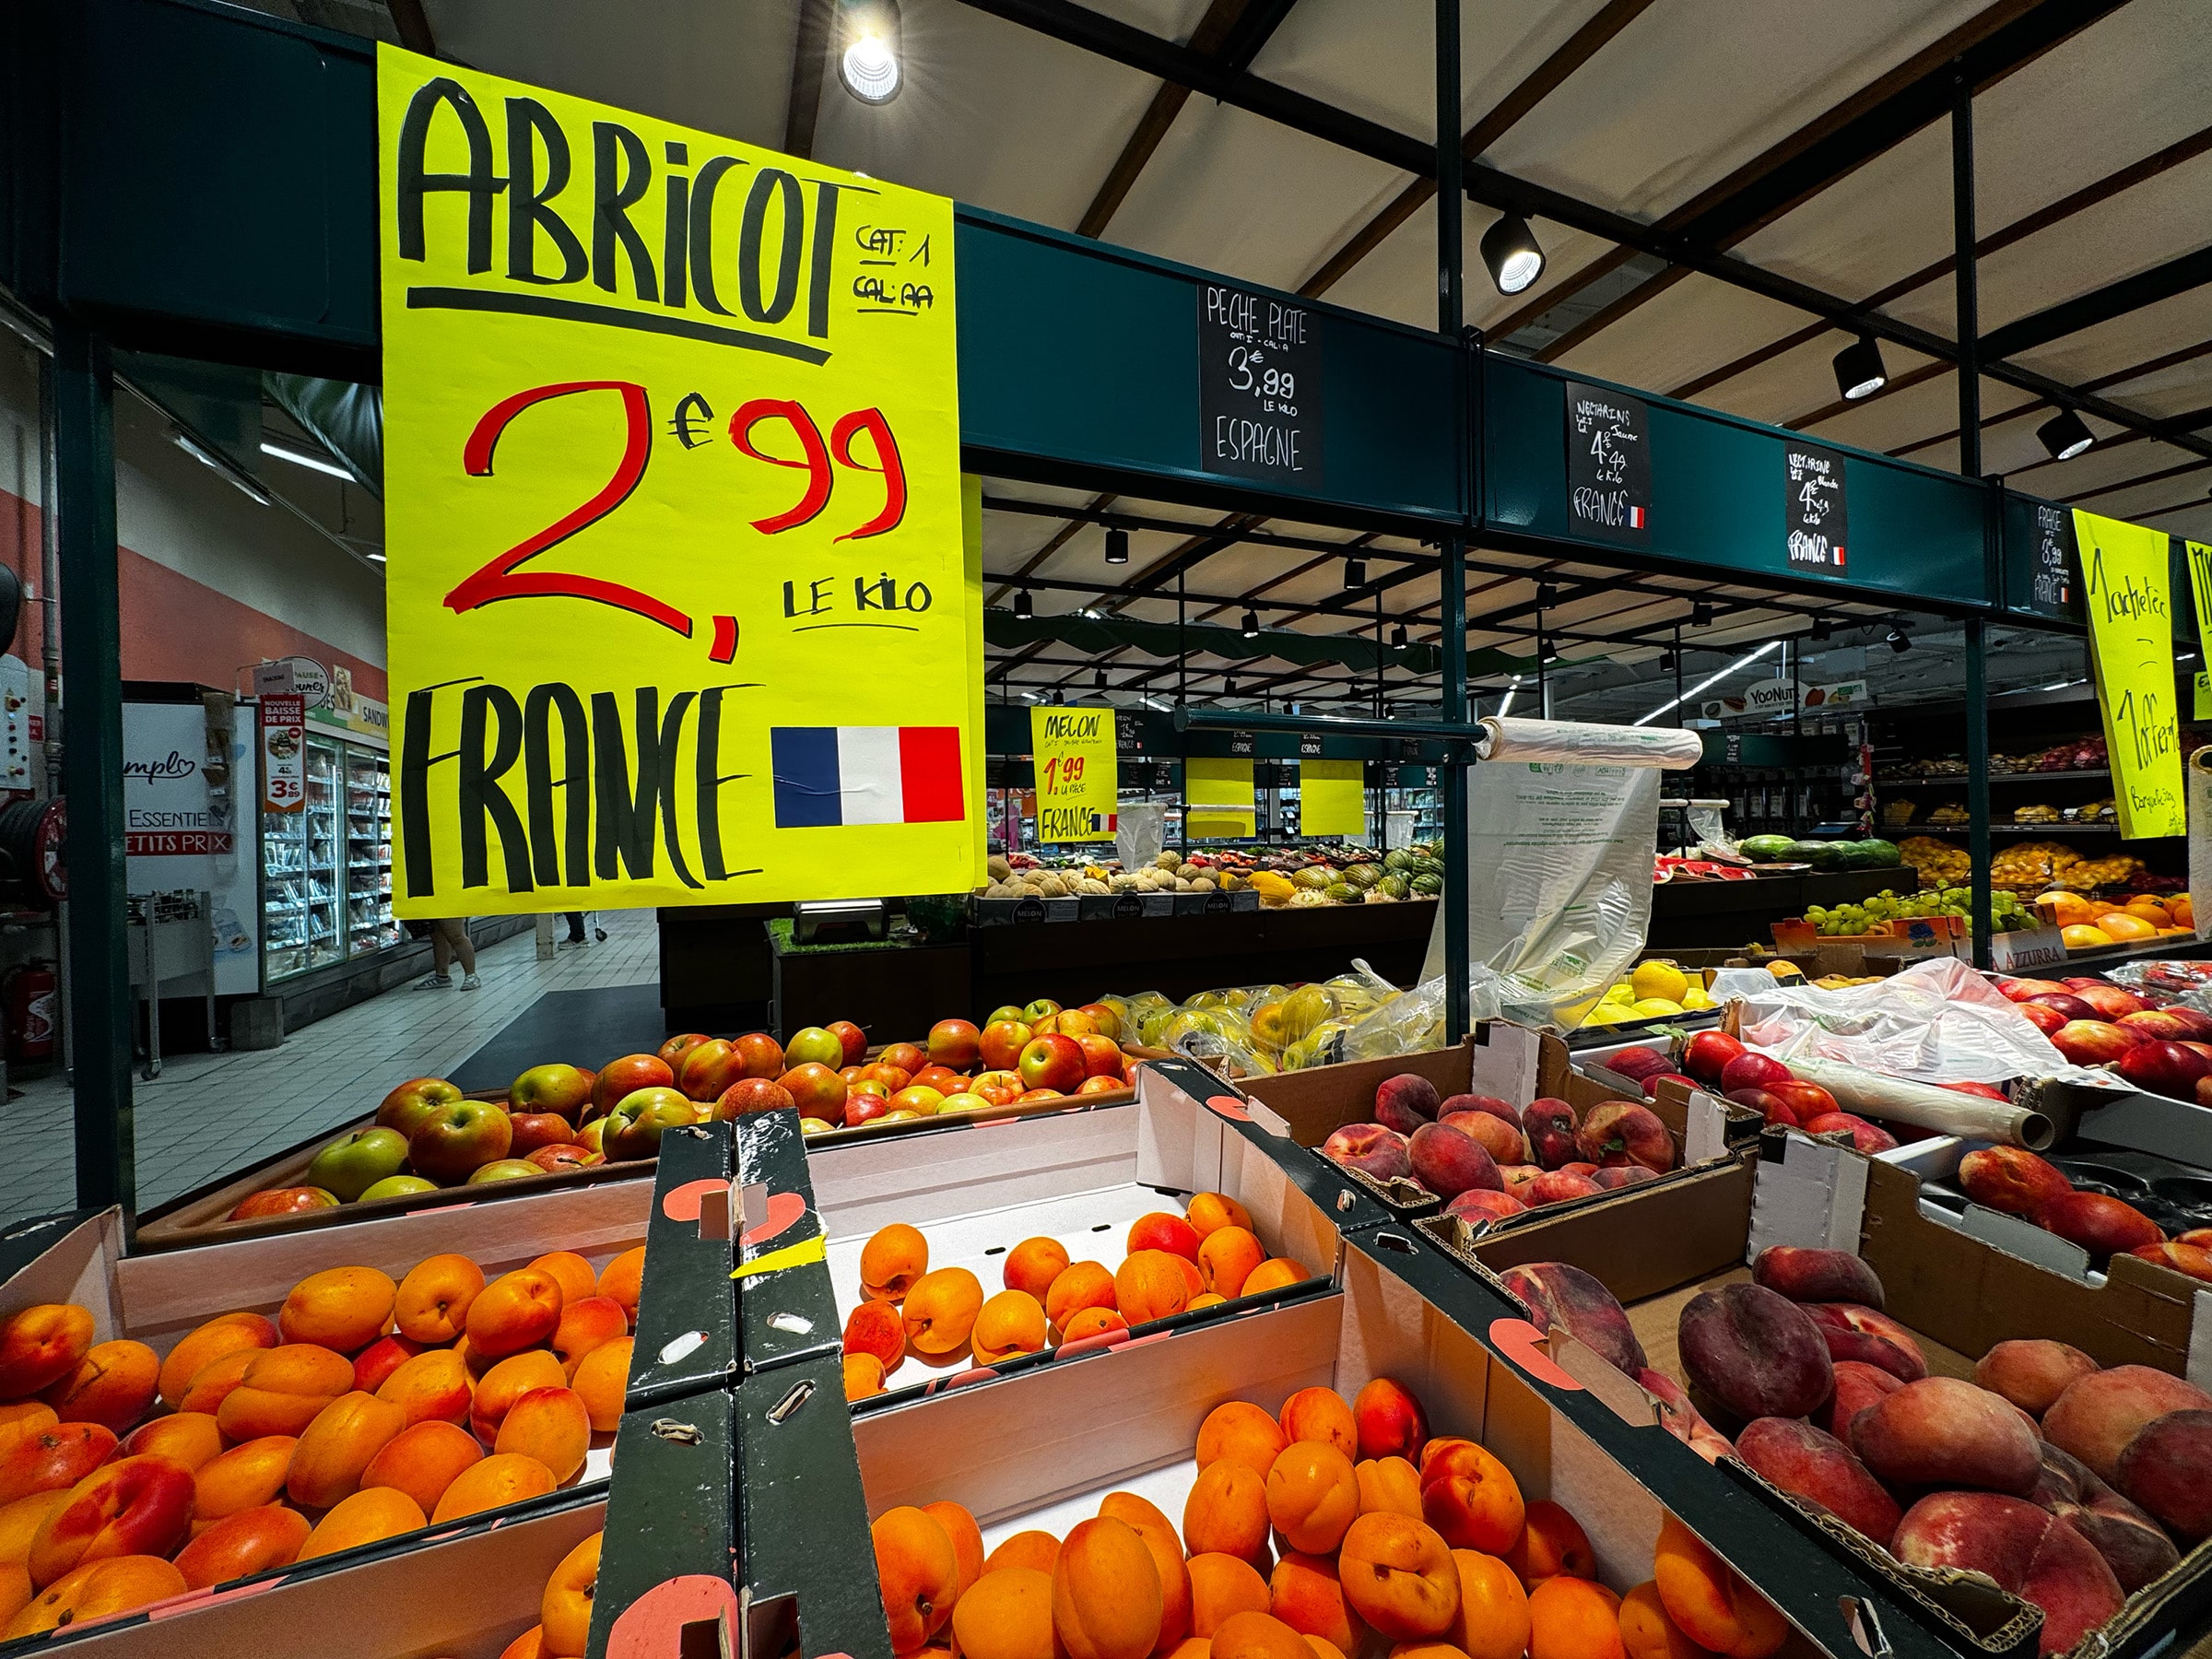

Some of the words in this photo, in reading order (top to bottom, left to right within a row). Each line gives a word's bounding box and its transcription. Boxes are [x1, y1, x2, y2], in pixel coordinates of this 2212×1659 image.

[1207, 287, 1259, 334] PECHE
[1268, 302, 1308, 344] PLATE
[1217, 416, 1303, 471] ESPAGNE
[1573, 487, 1629, 526] FRANCE
[1787, 530, 1828, 564] FRANCE
[783, 576, 833, 618] LE
[1750, 687, 1800, 704] YOONUT
[363, 706, 388, 728] SANDW
[1044, 714, 1100, 739] MELON
[400, 676, 767, 898] FRANCE
[1041, 806, 1095, 839] FRANCE
[125, 835, 177, 852] ETITS
[182, 834, 229, 851] PRIX
[2006, 946, 2063, 971] AZZURRA
